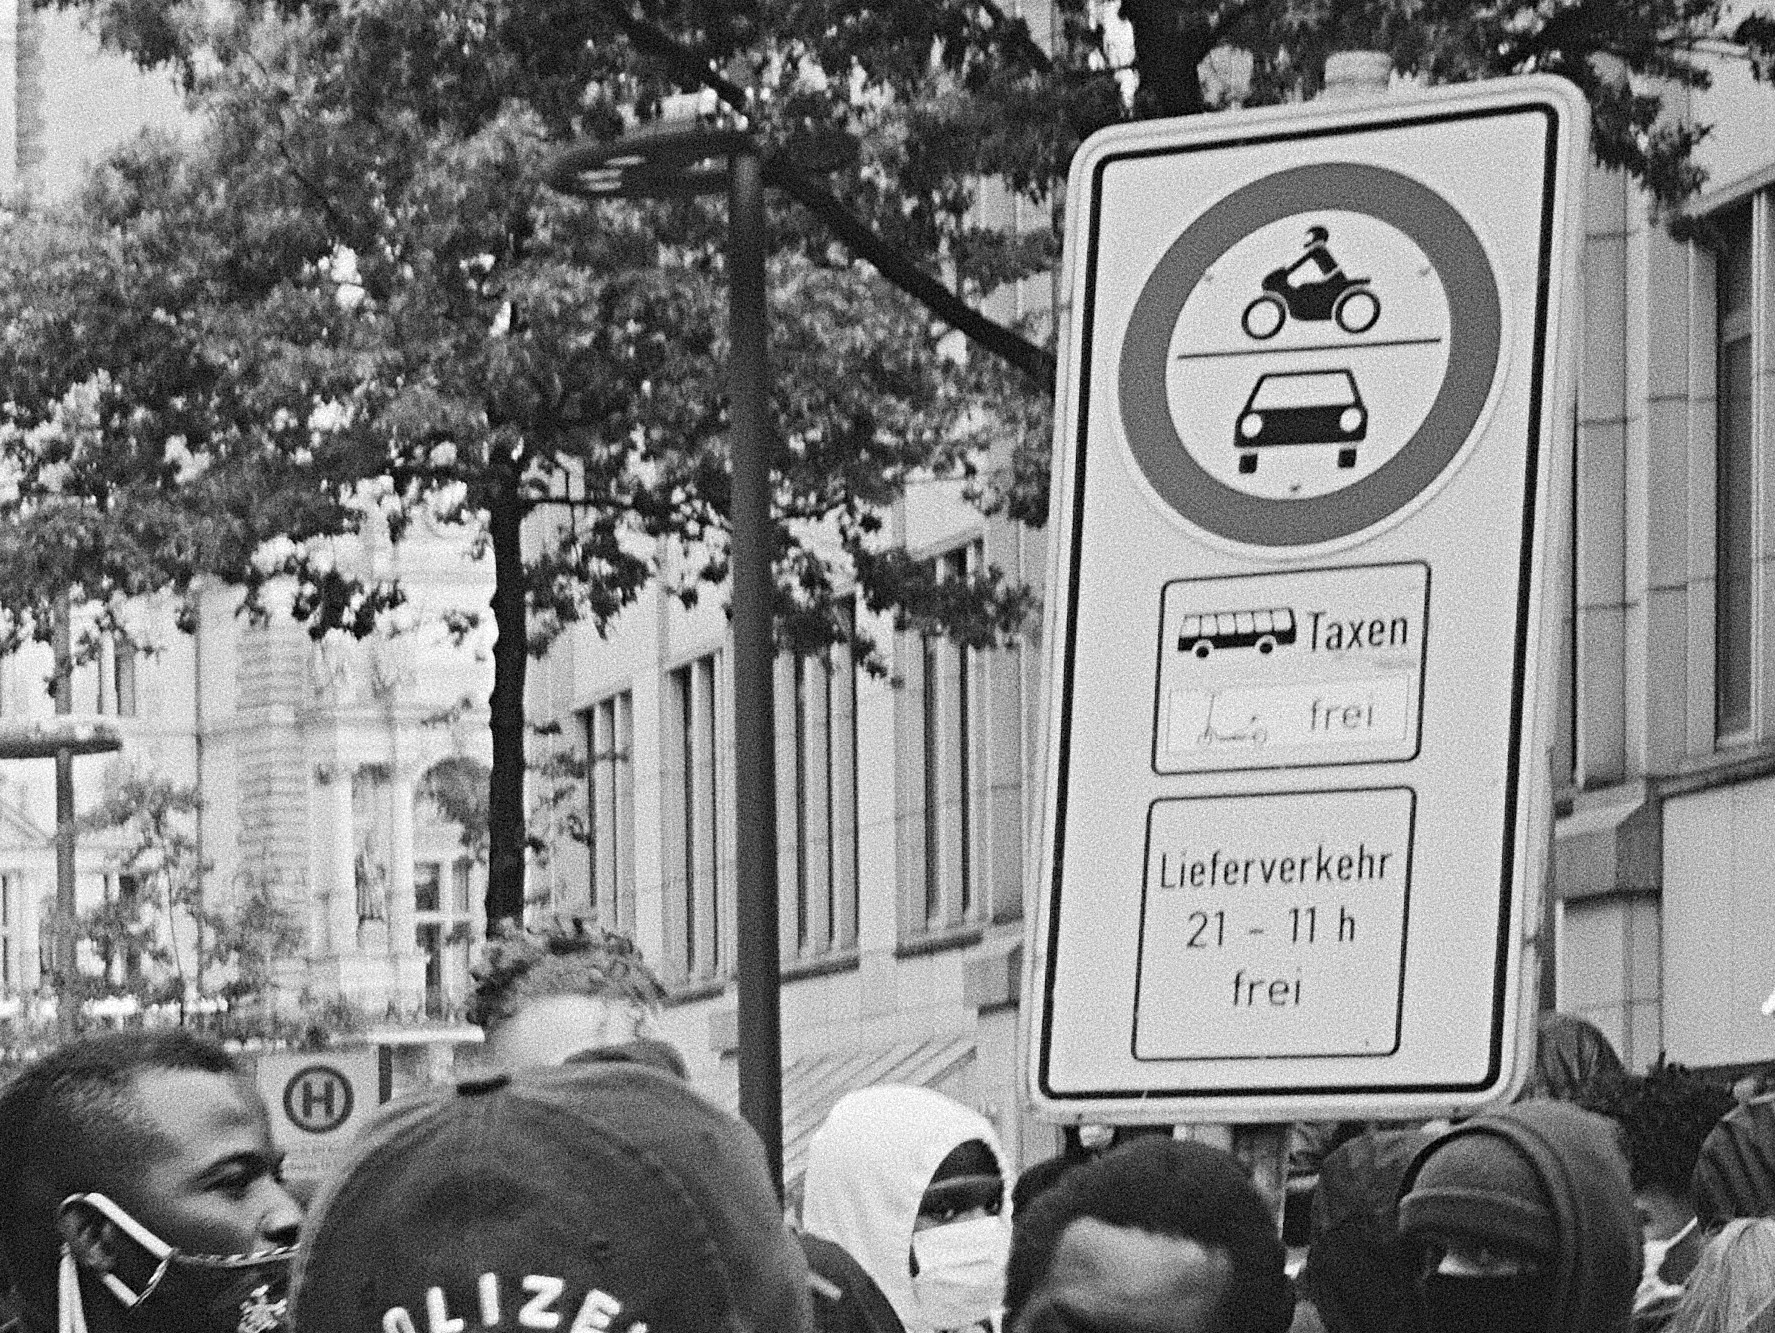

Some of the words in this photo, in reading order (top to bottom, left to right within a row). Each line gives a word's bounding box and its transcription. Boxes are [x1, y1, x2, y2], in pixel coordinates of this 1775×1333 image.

[1307, 611, 1409, 652] Taxen
[1310, 698, 1374, 731] frei
[1160, 843, 1392, 889] Lieferverkehr
[1187, 909, 1225, 949] 21
[1288, 904, 1316, 944] 11
[1337, 904, 1356, 943] h
[1232, 967, 1302, 1007] frei
[302, 1080, 334, 1118] H
